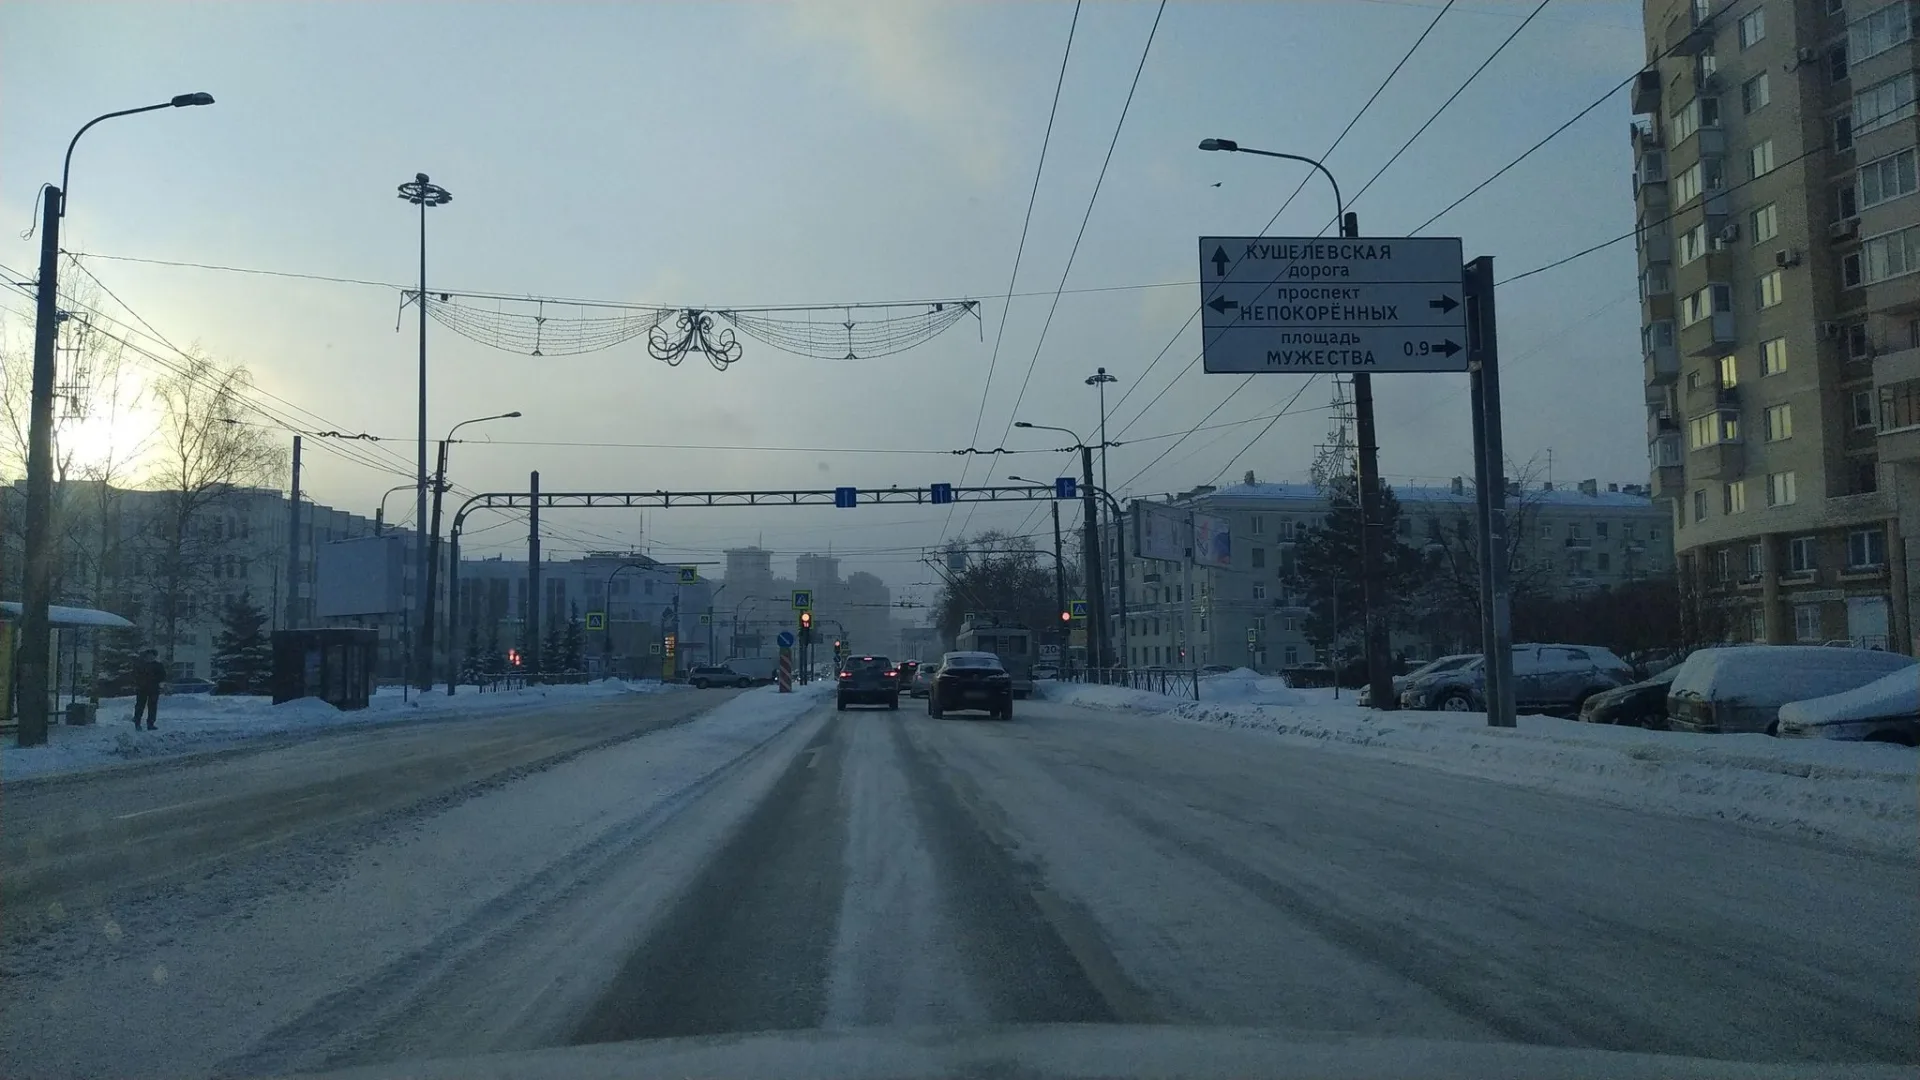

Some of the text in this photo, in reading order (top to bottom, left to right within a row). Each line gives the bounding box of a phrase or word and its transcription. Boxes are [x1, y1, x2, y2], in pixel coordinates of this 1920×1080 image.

[1246, 244, 1392, 260] КУШЕЛЕВСКАЯ
[1288, 264, 1350, 279] дорога
[1277, 287, 1360, 301] проспект
[1240, 303, 1399, 322] НЕПОКОРЁННЫХ
[1281, 332, 1361, 345] площадь
[1403, 341, 1430, 357] 0.9
[1266, 350, 1376, 366] МУЖЕСТВА
